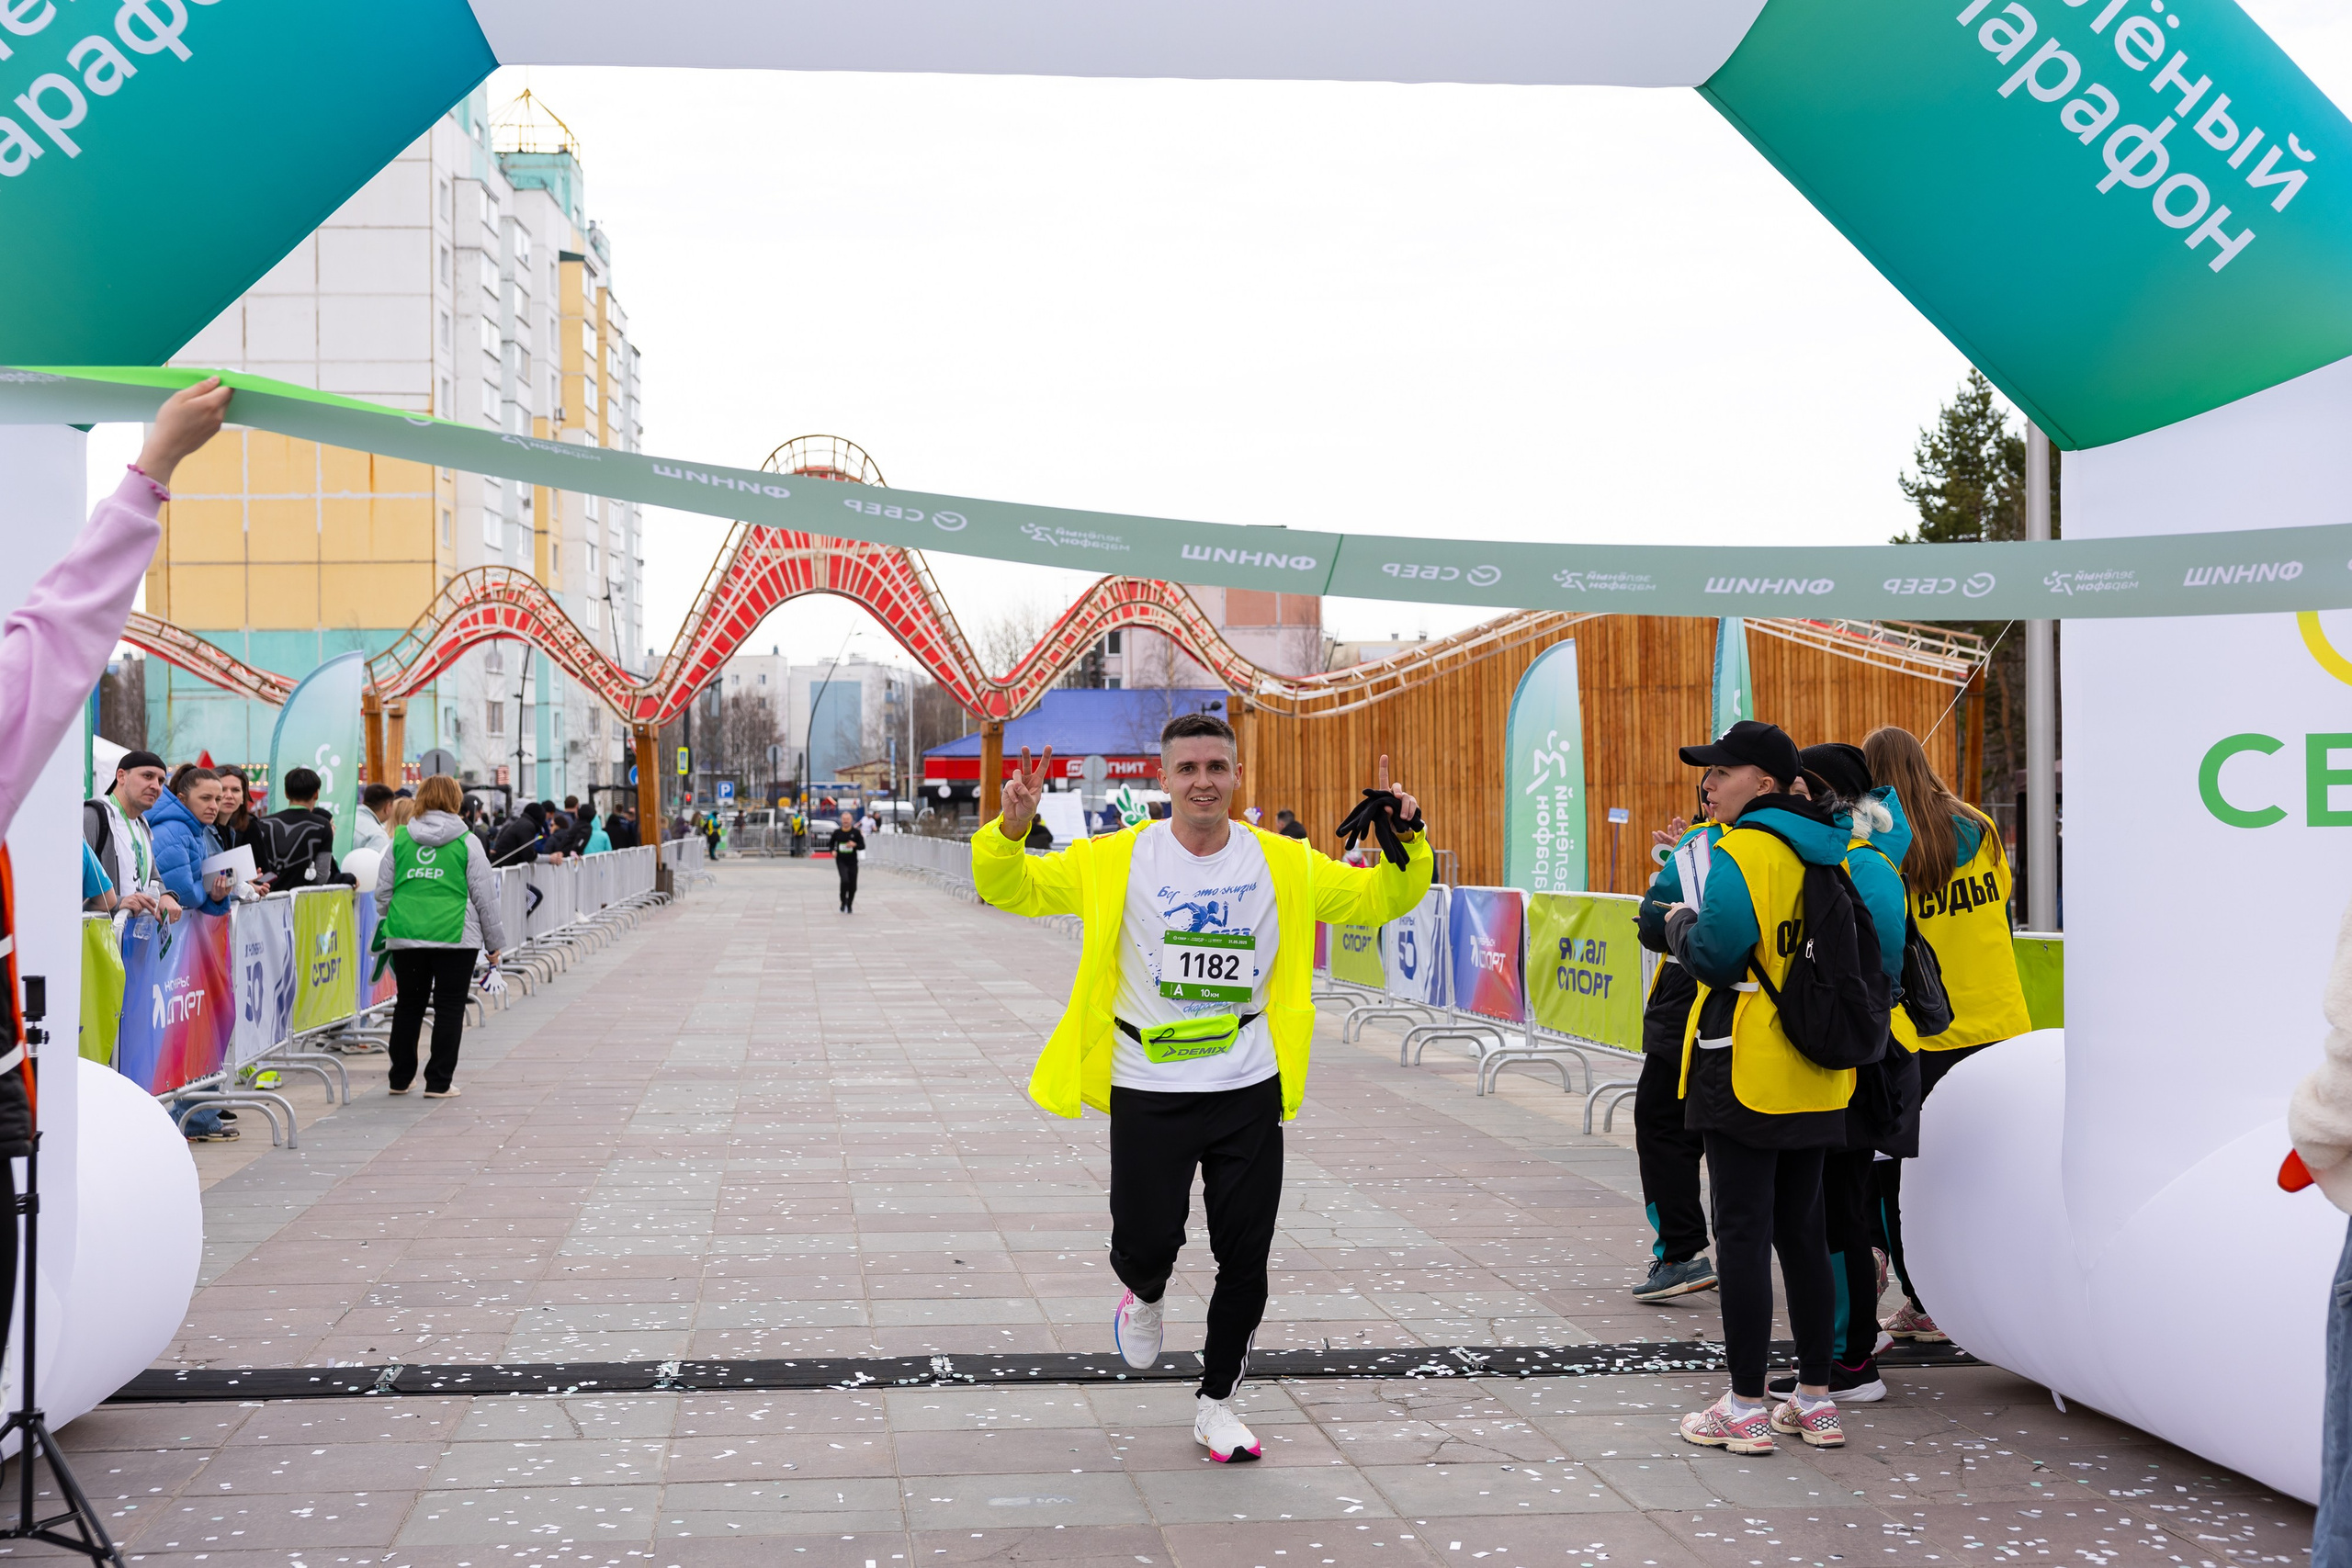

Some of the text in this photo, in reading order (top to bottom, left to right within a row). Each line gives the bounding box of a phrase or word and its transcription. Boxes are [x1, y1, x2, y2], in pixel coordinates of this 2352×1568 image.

[0, 0, 223, 176] араф
[2061, 0, 2316, 213] ёный
[1108, 761, 1147, 774] ГНИТ
[407, 867, 445, 880] СБЕР
[1917, 871, 2001, 919] СУДЬЯ
[1180, 952, 1240, 980] 1182
[1556, 965, 1613, 999] СПОРТ
[1177, 1045, 1227, 1056] DEMIX
